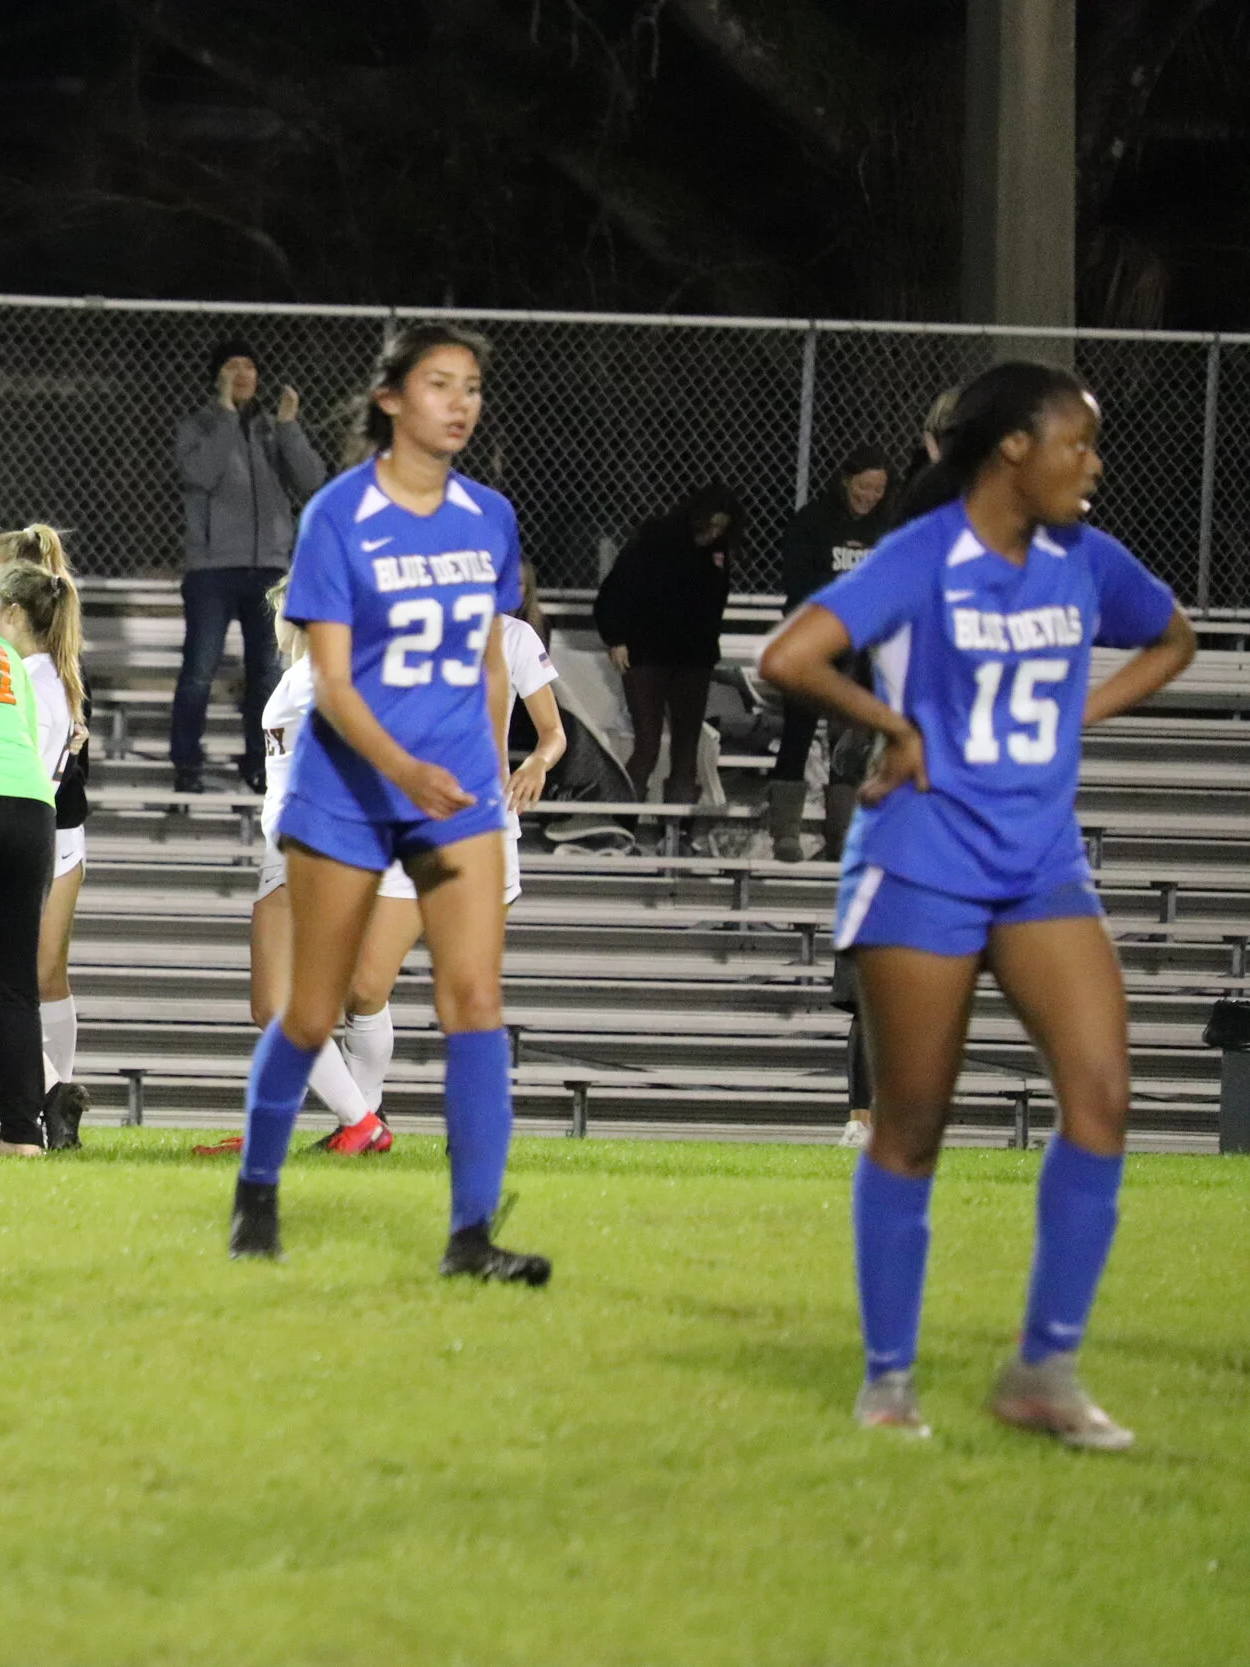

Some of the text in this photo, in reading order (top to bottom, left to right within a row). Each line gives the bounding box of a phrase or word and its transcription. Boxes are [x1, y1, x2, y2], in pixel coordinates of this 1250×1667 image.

[372, 550, 498, 592] BLUE DEVILS
[381, 594, 494, 687] 23
[953, 604, 1083, 653] BLUE DEVILS
[963, 659, 1070, 765] 15
